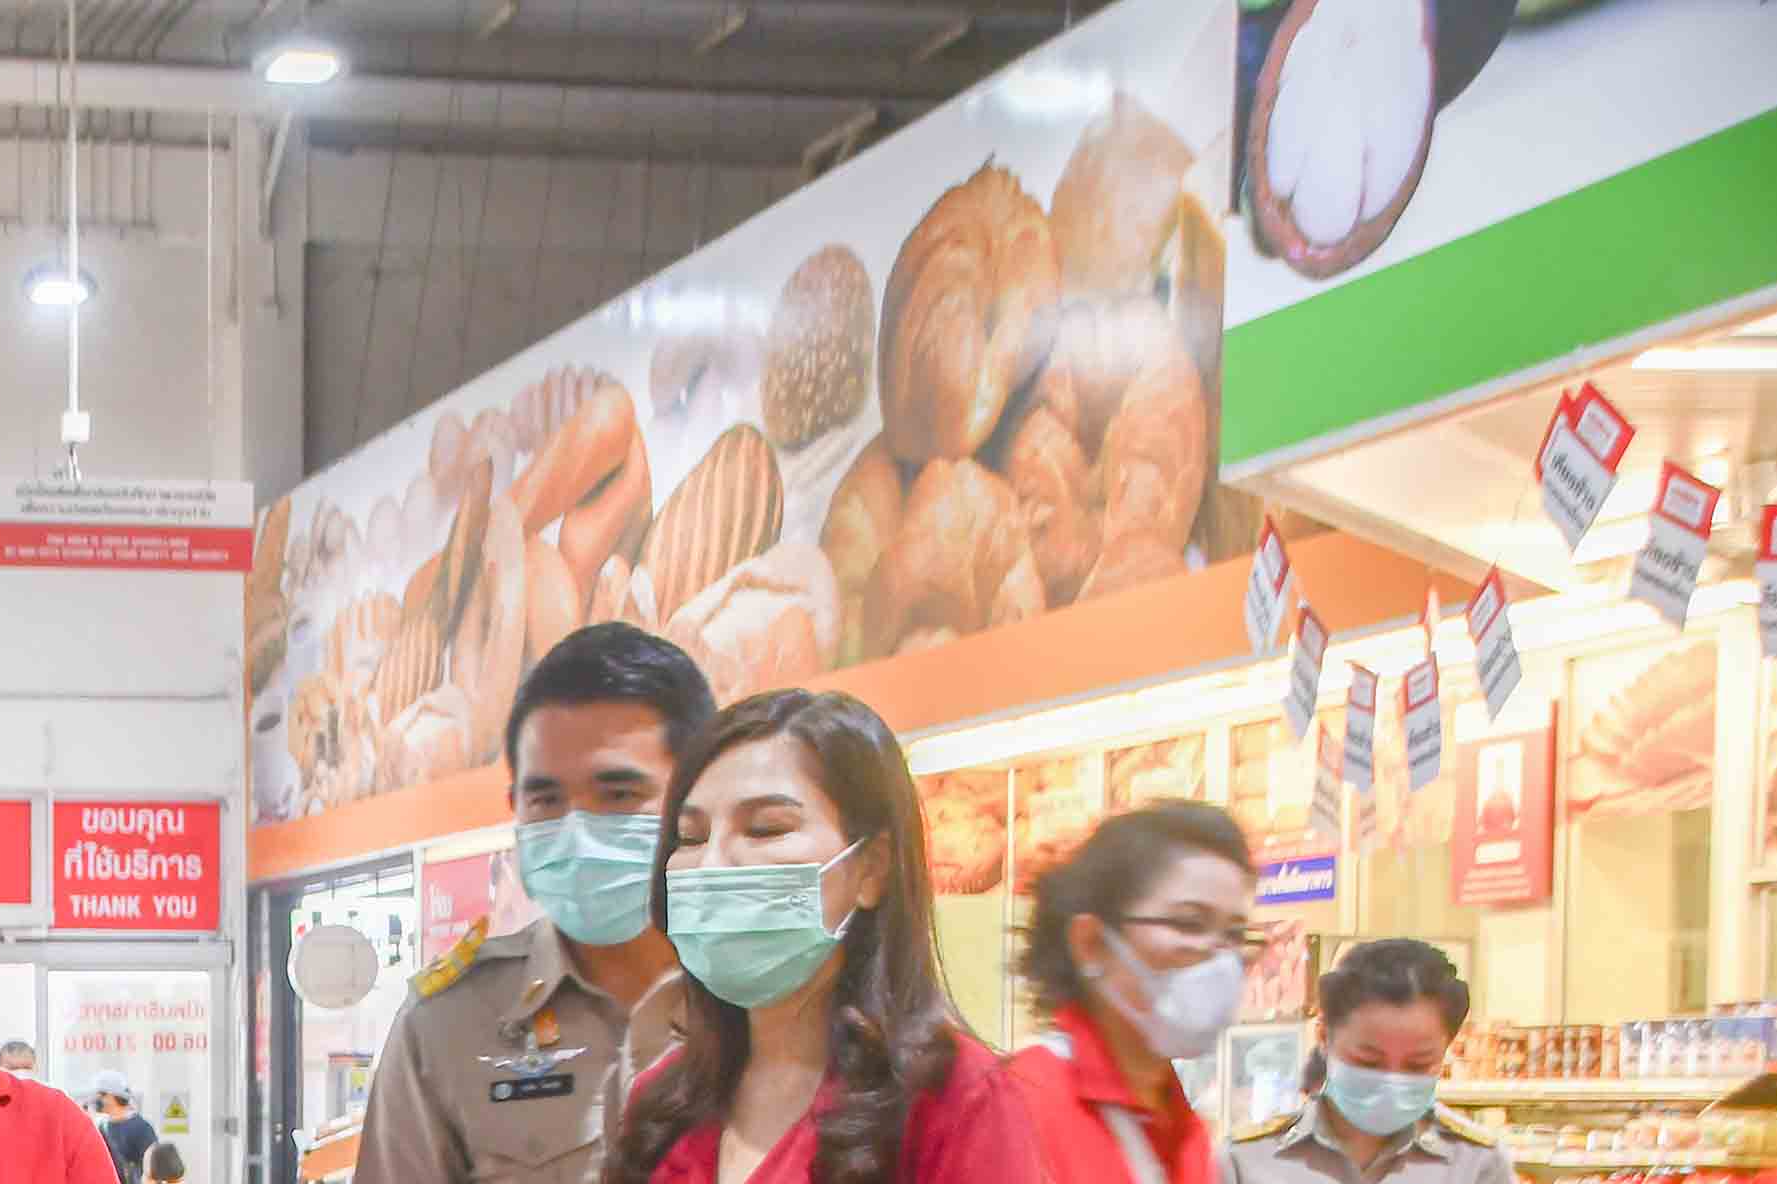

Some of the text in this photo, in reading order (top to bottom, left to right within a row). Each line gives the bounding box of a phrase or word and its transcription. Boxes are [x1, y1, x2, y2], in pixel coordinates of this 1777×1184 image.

[82, 808, 185, 843] ขอบคุณ
[63, 840, 203, 881] ที่ใช้บริการ
[70, 895, 197, 919] THANK YOU
